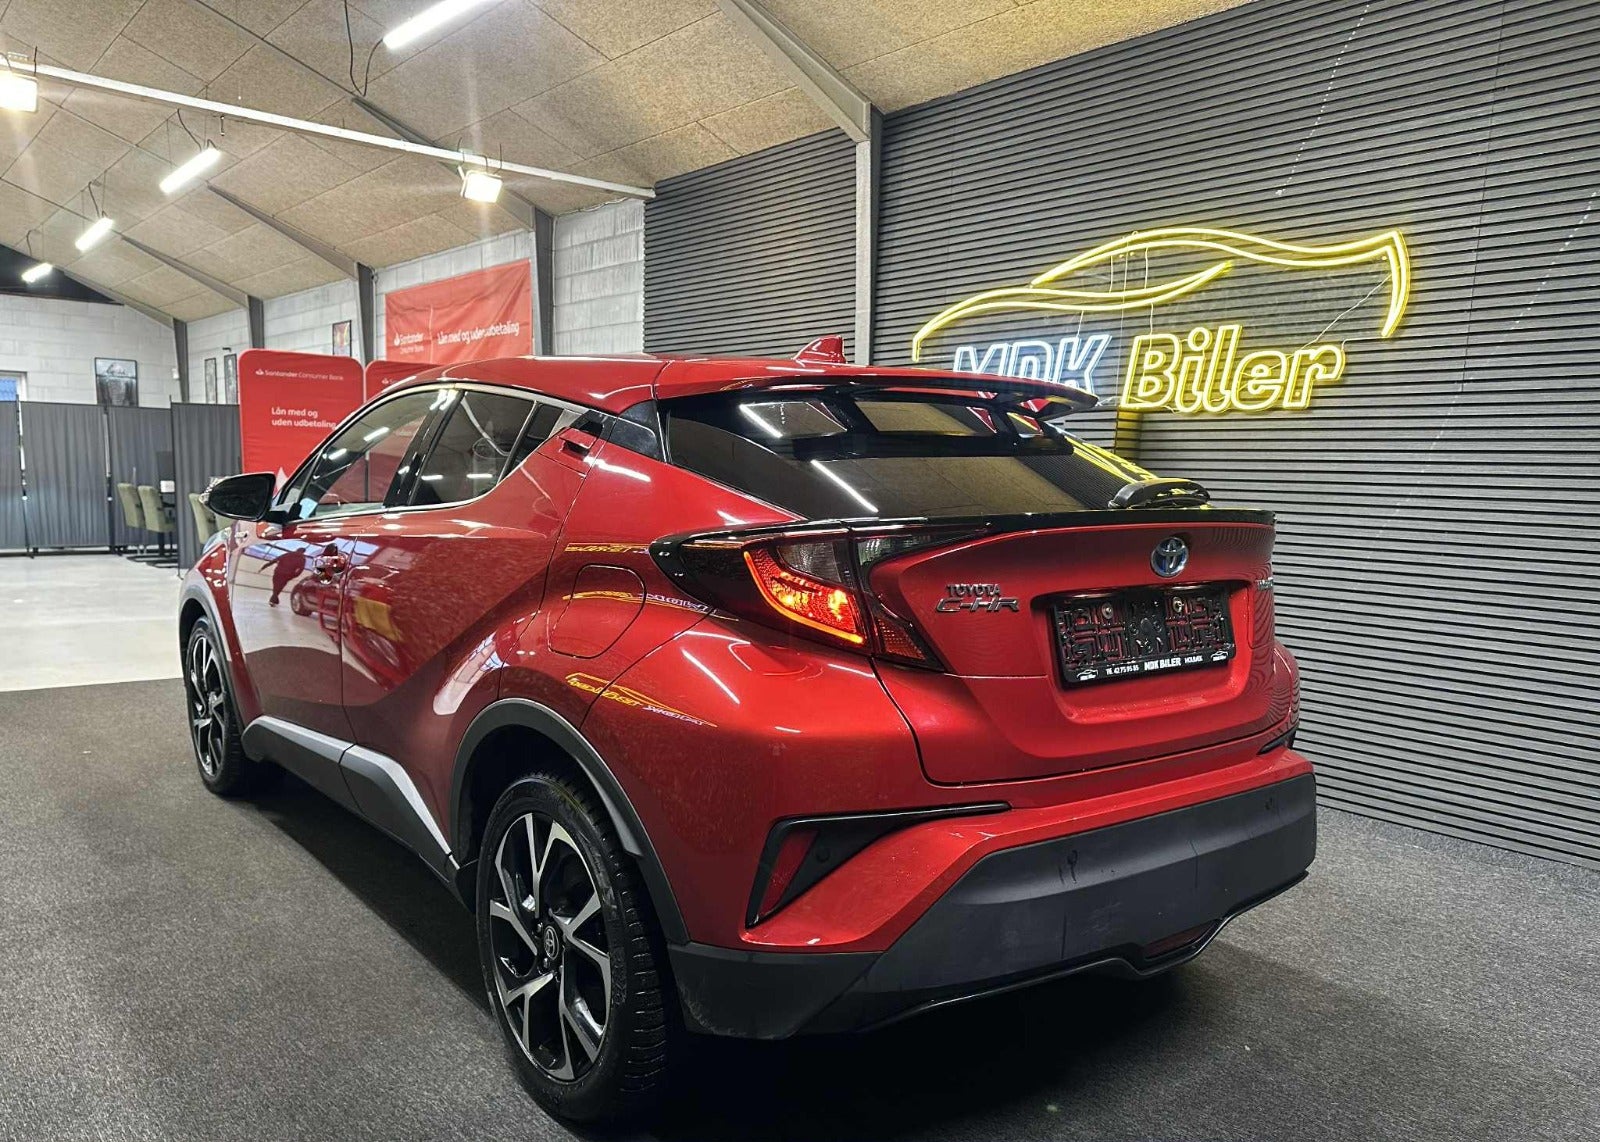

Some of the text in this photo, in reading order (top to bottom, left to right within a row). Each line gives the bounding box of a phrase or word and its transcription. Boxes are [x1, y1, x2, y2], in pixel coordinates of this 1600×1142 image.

[264, 369, 298, 378] Santander
[298, 371, 328, 380] Consumer
[953, 324, 1346, 413] MDK Biler
[271, 406, 318, 419] Lån med og
[271, 418, 337, 430] uden udbetaling
[946, 583, 1001, 597] TOYOTA
[936, 596, 1019, 612] C-HR
[1159, 657, 1181, 669] BILER
